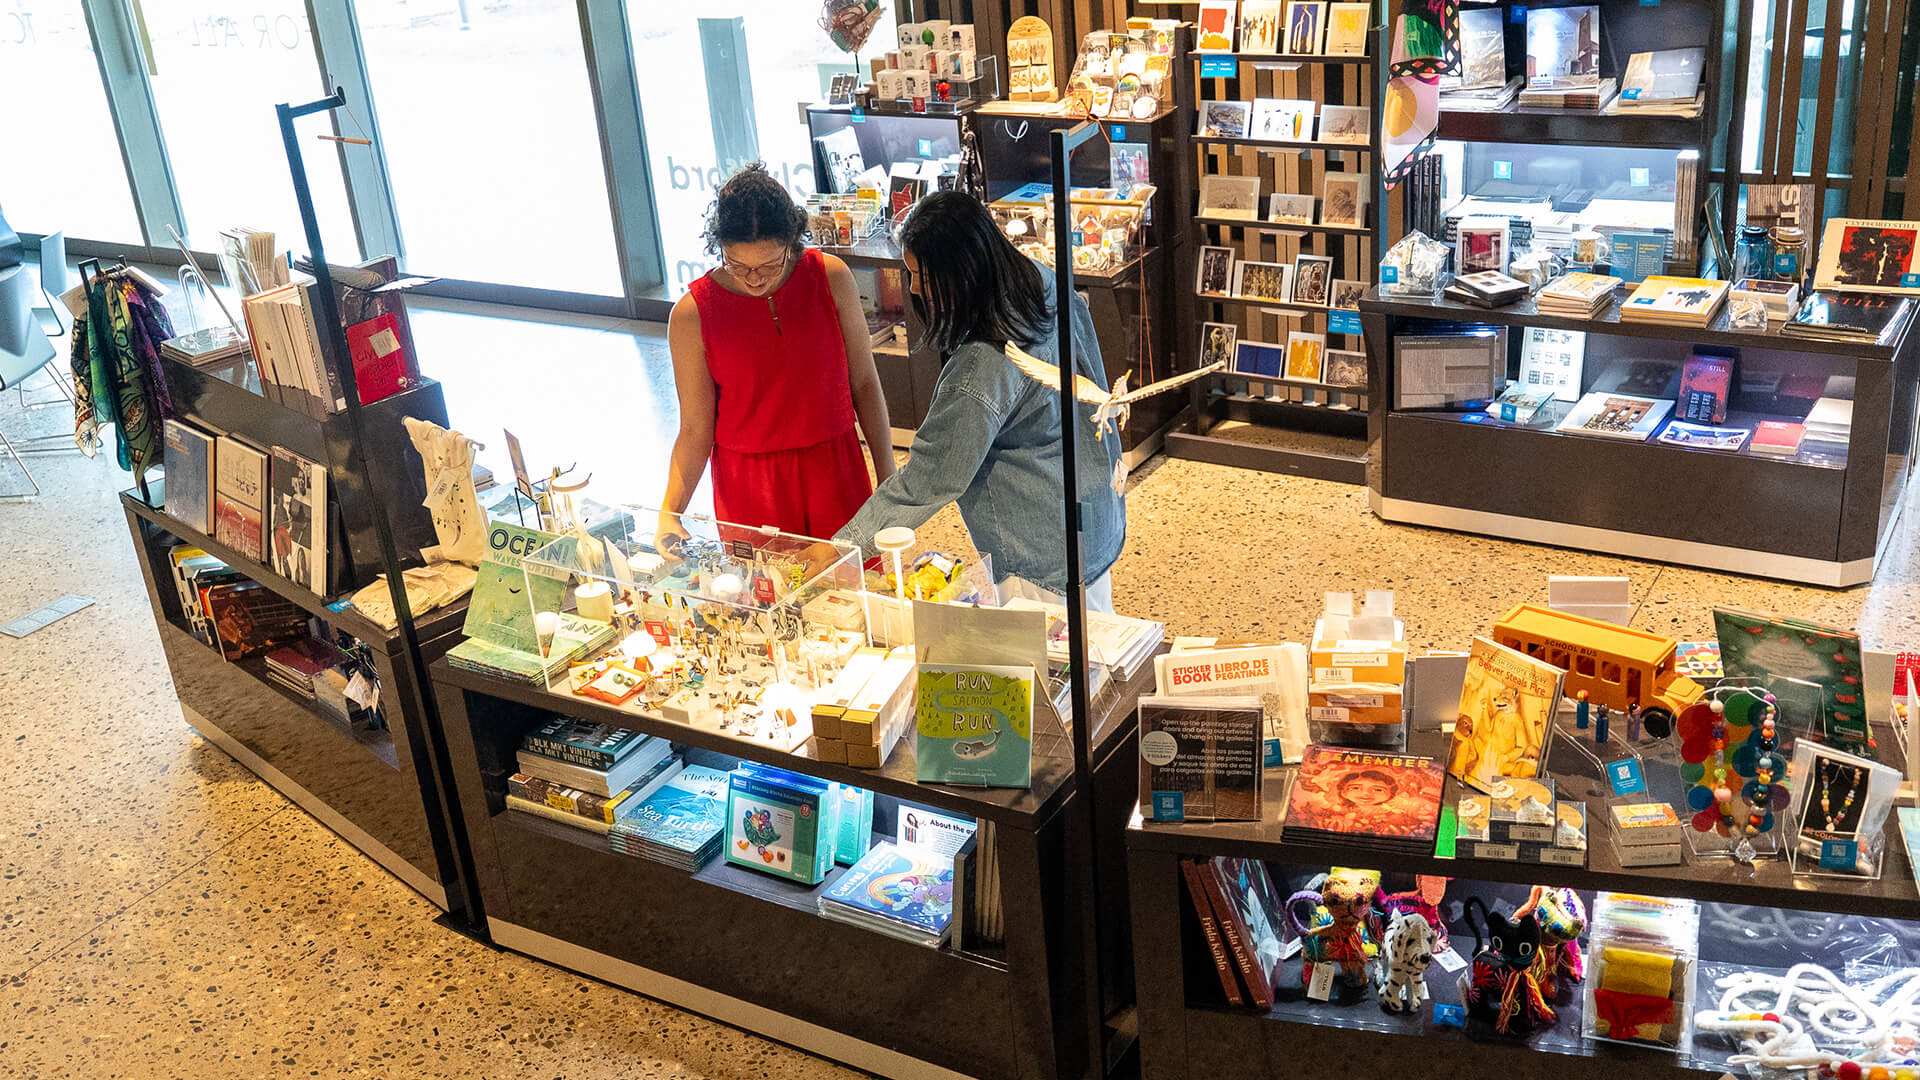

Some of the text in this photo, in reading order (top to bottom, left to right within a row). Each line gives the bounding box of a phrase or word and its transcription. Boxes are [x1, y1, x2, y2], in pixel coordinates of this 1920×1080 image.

[1827, 297, 1888, 308] STILL
[1709, 365, 1726, 373] STILL
[490, 529, 570, 564] OCEAN!
[493, 552, 521, 567] WAVES
[1545, 640, 1598, 657] SCHOOL BUS
[1172, 664, 1211, 675] STICKER
[1214, 658, 1269, 673] LIBRO DE
[955, 672, 993, 691] RUN
[1173, 671, 1212, 686] BOOK
[1215, 668, 1269, 681] PEGATINAS
[1479, 657, 1546, 697] Beaver Steals Fire
[953, 694, 993, 706] SALMON
[541, 719, 569, 735] BLK
[953, 711, 993, 732] RUN
[1161, 719, 1178, 727] Open
[533, 737, 601, 760] BLK MKT VINTAGE
[545, 748, 561, 758] MKT
[563, 752, 593, 767] VINTAGE
[1318, 751, 1430, 769] REMEMBER
[681, 773, 705, 781] The
[638, 804, 663, 821] Sea
[664, 814, 716, 832] Turtle
[930, 819, 951, 830] About
[952, 824, 965, 833] the
[1202, 917, 1227, 970] Frida Kahlo
[1224, 920, 1251, 974] Frida Kahlo
